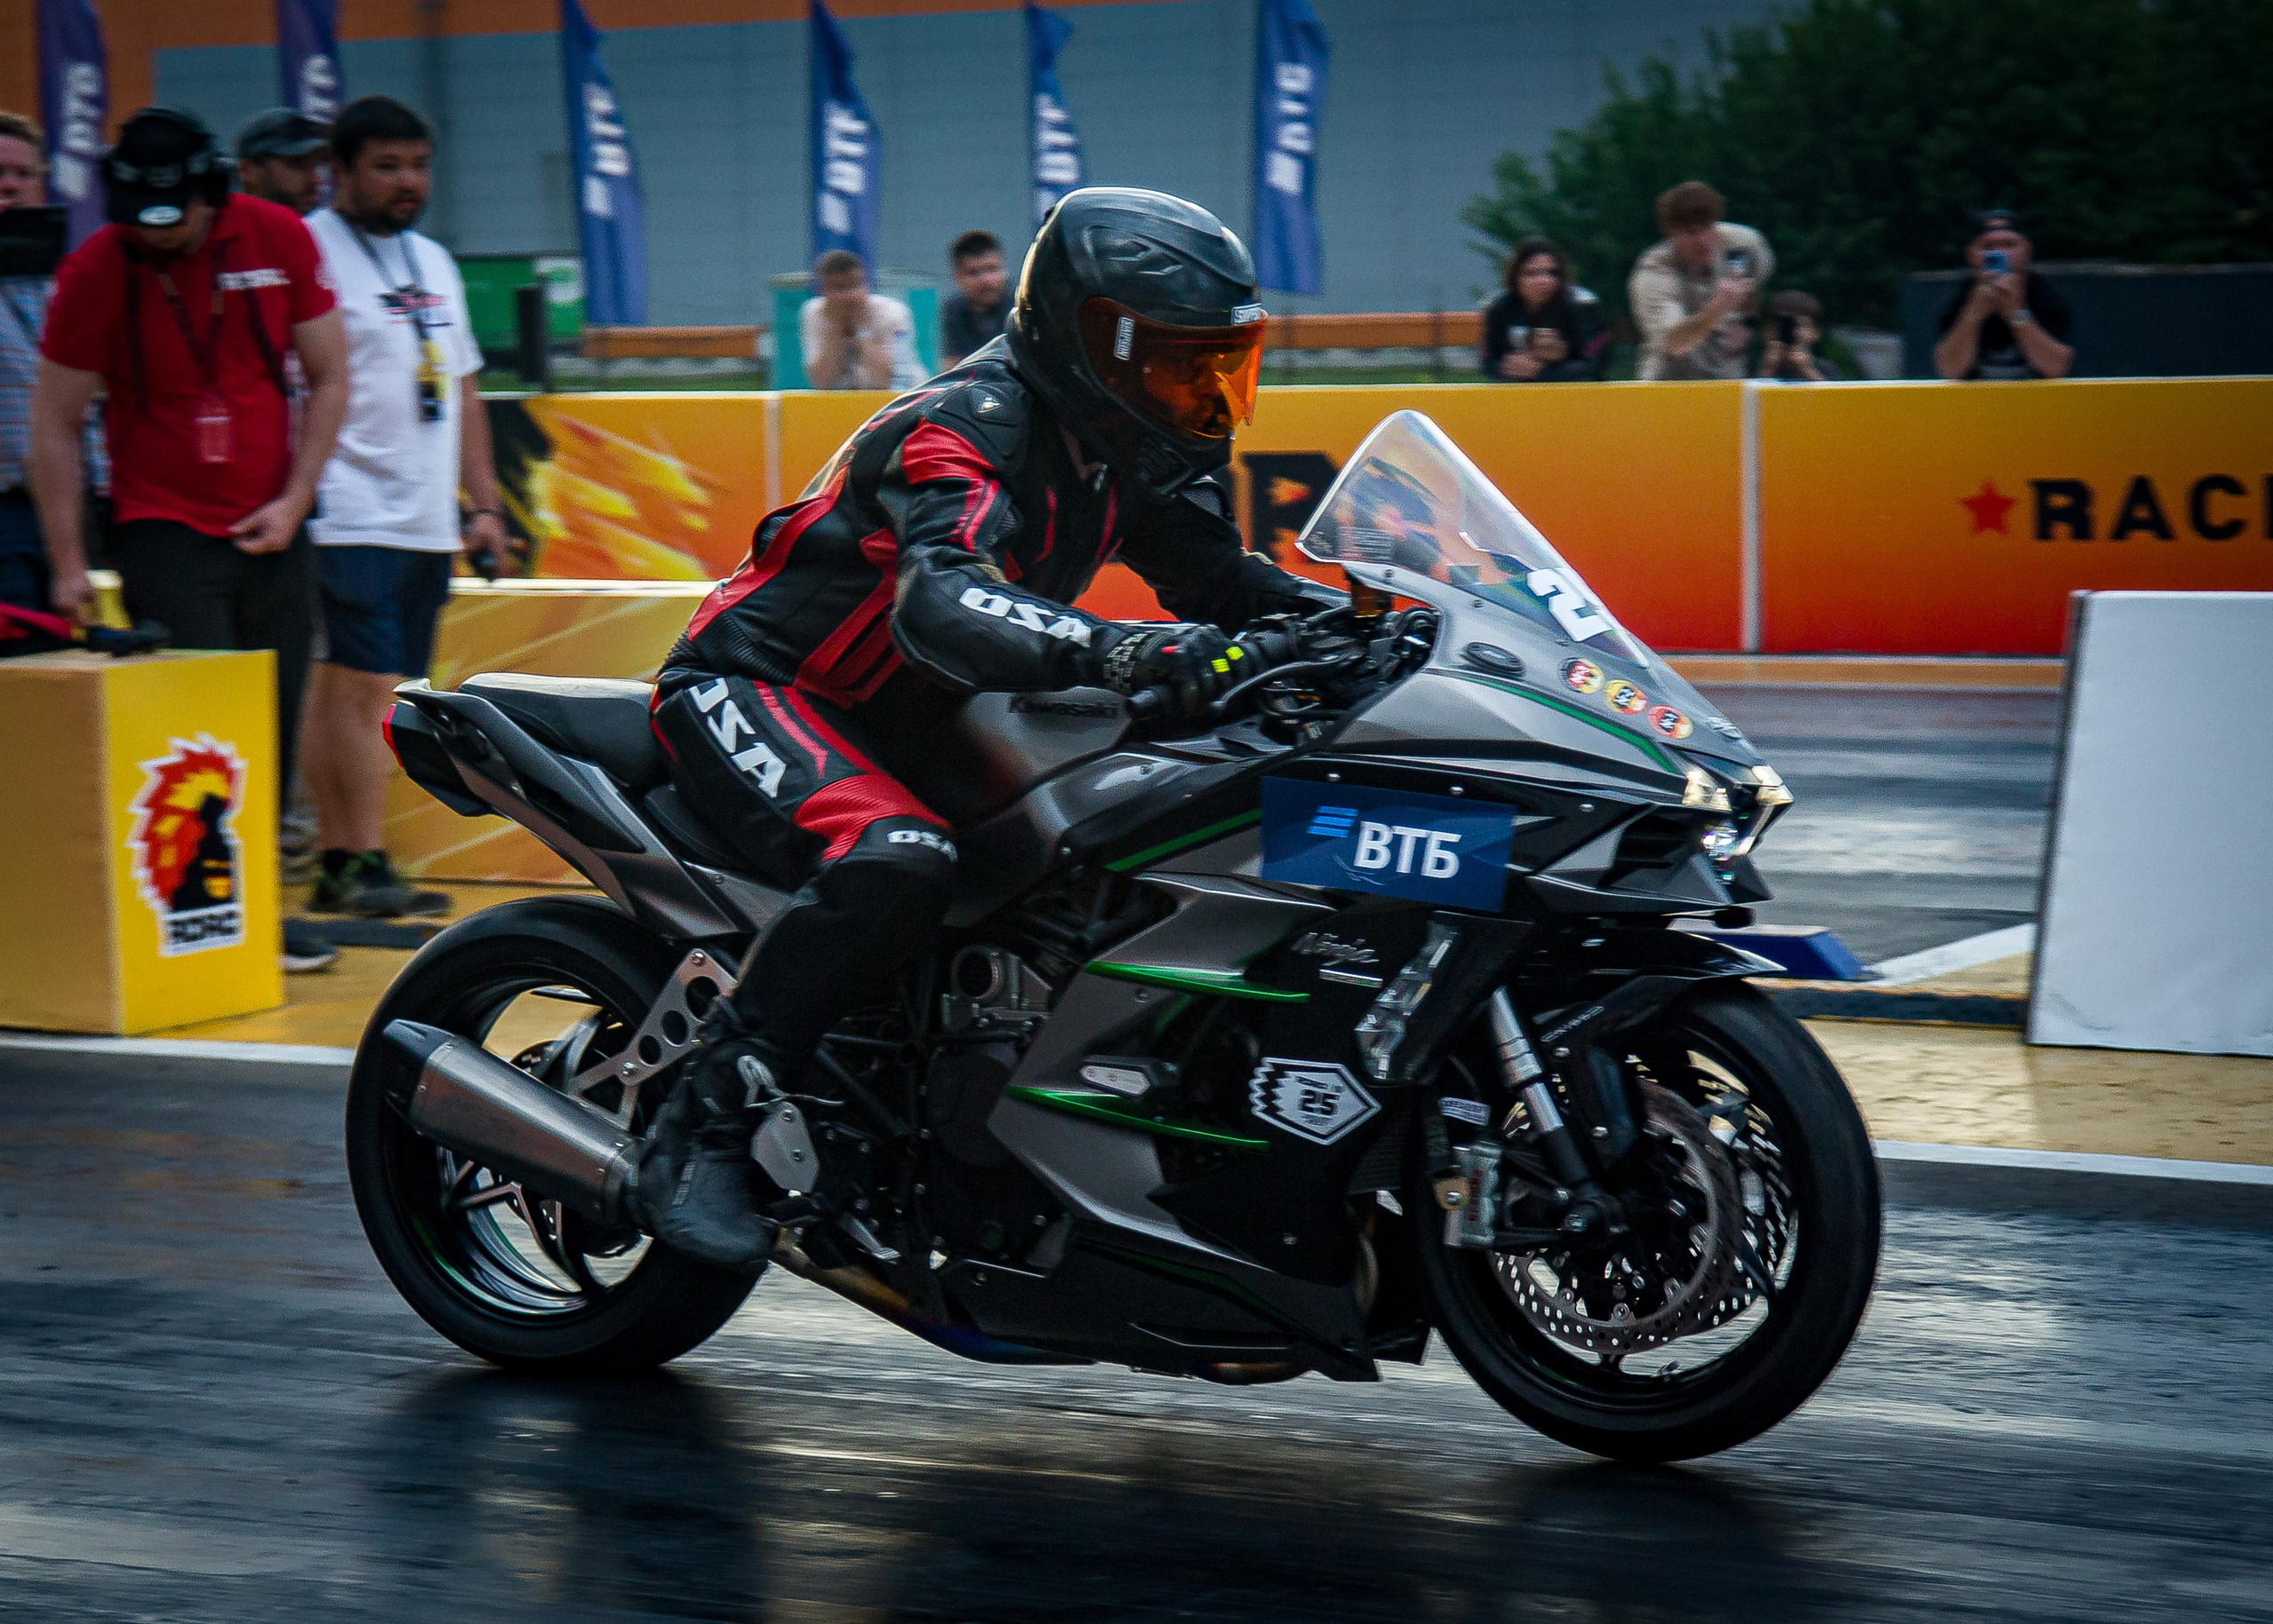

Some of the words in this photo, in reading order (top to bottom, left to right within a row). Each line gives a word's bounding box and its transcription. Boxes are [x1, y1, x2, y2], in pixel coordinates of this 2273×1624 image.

[959, 587, 1092, 648] OSA
[1353, 820, 1462, 879] ВТБ
[1298, 1089, 1341, 1116] 25
